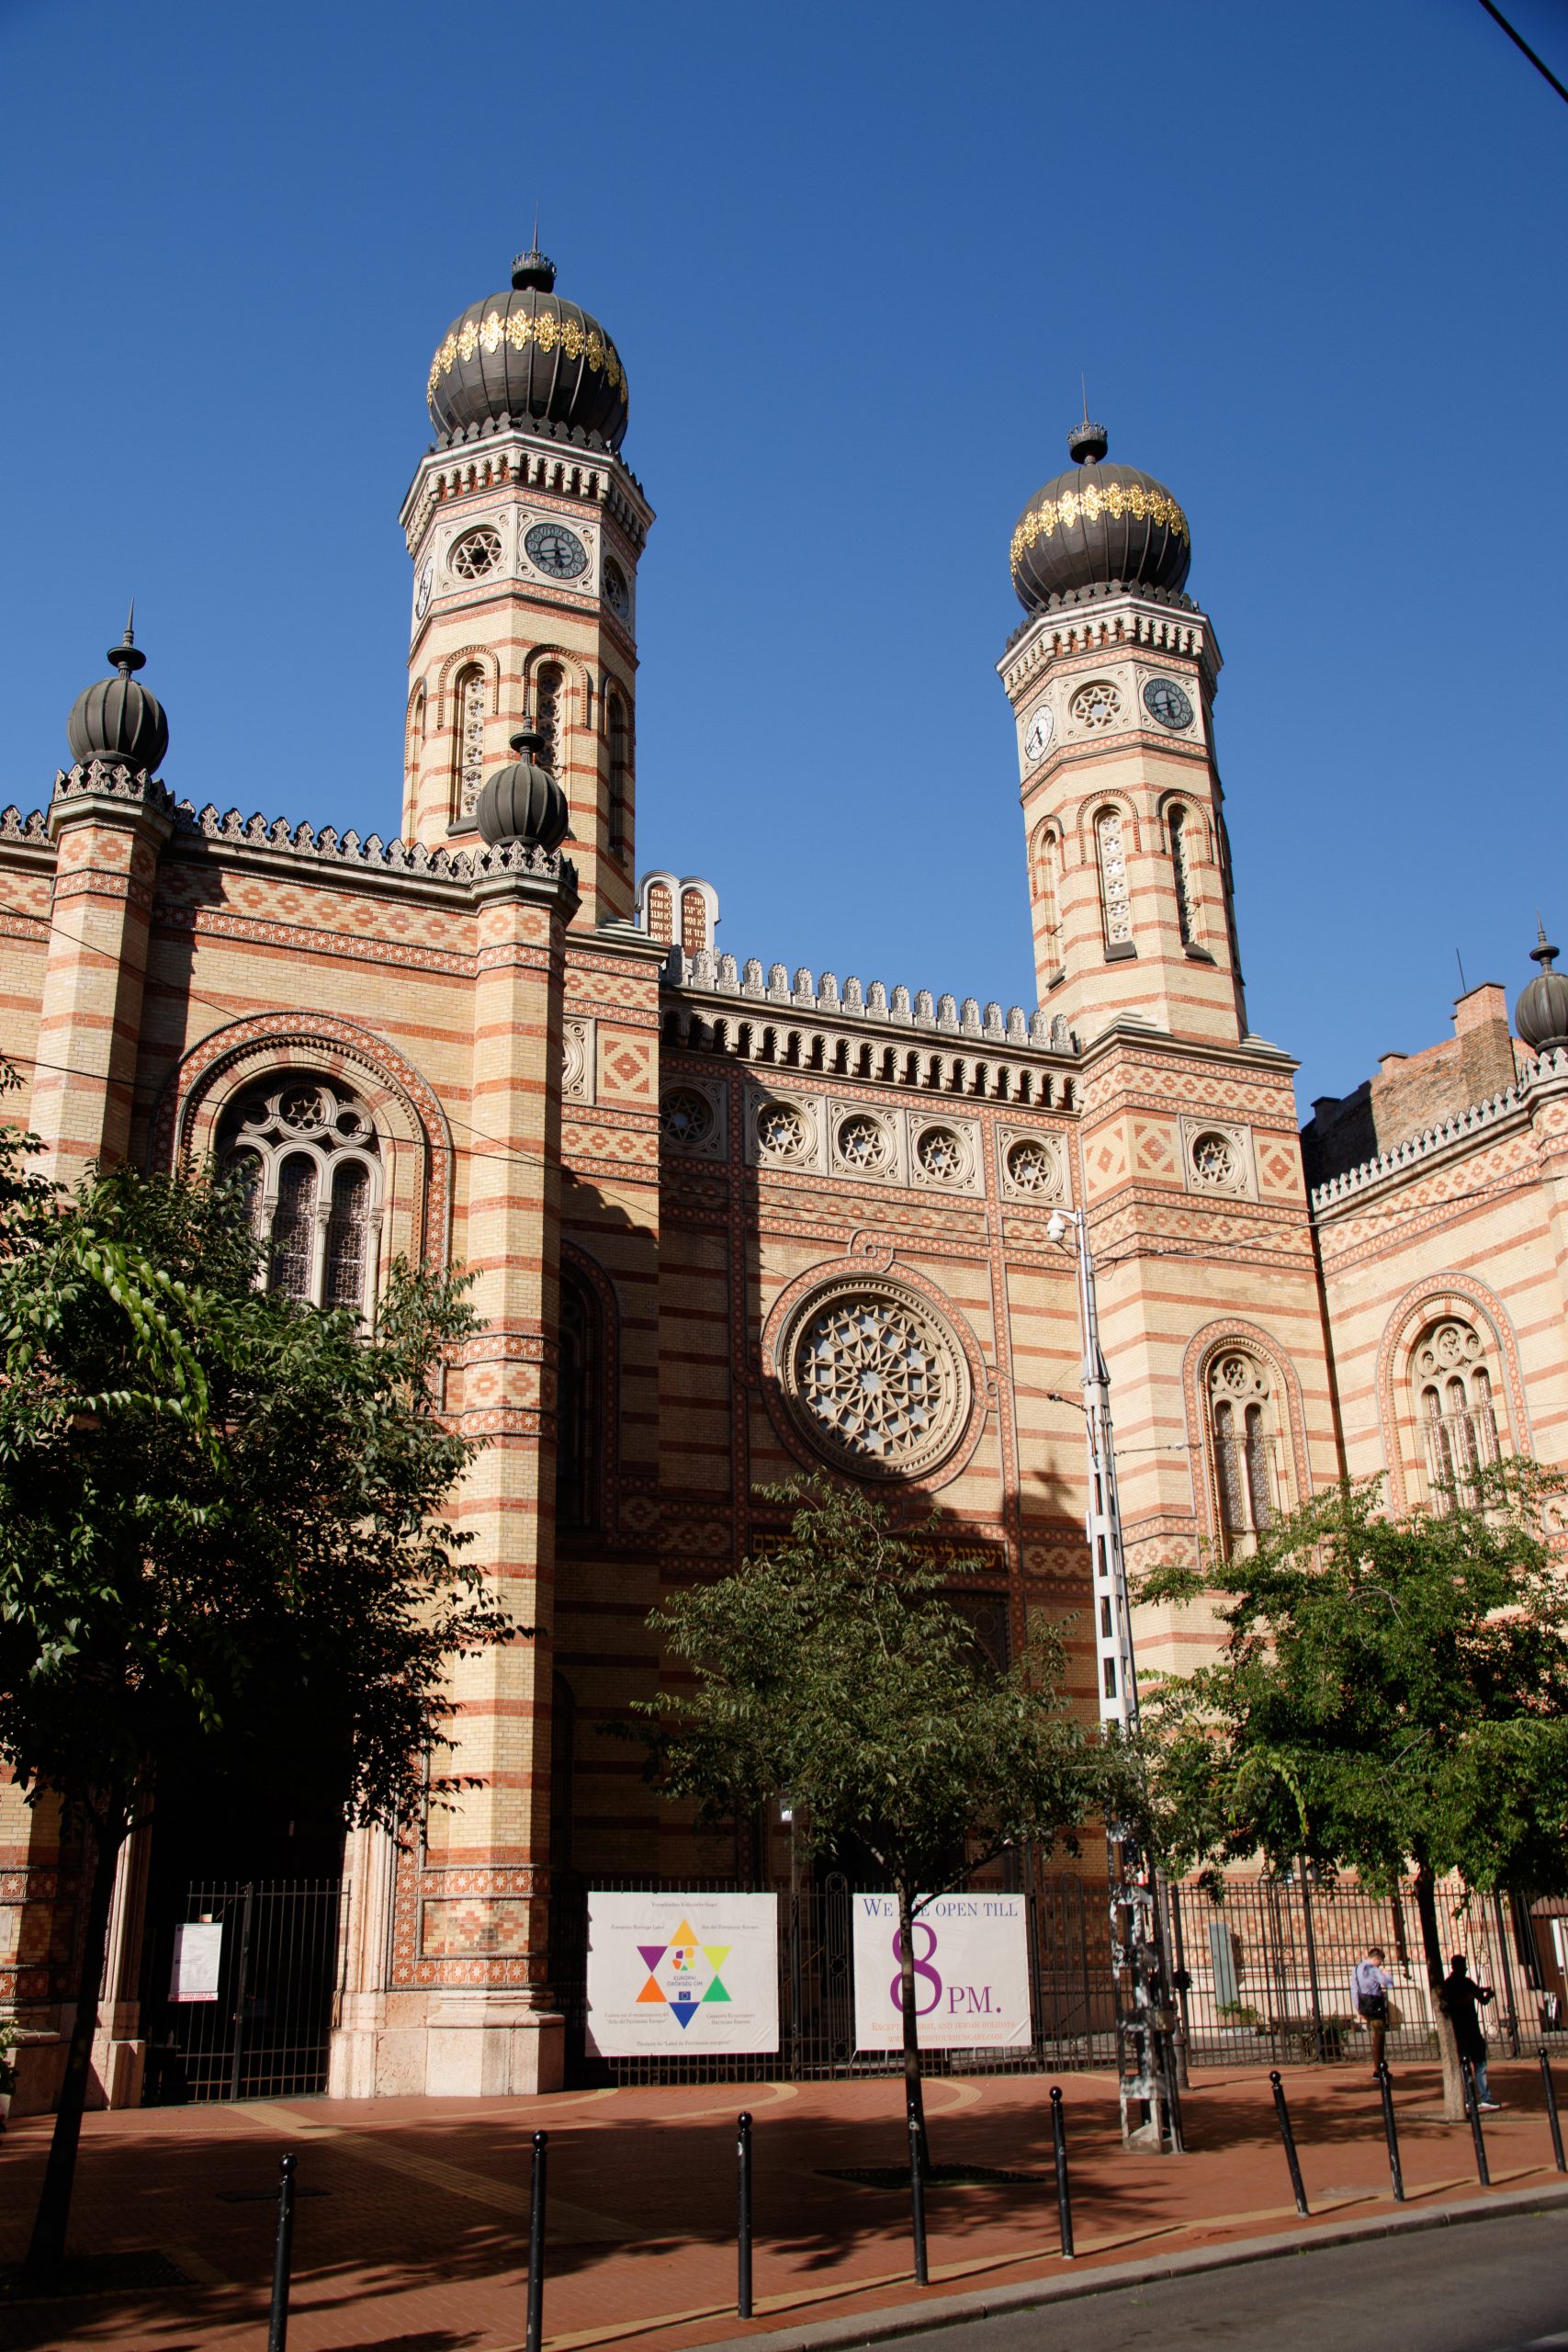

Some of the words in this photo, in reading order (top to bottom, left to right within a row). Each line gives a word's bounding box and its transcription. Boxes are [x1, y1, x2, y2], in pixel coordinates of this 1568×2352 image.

[935, 1902, 978, 1917] OPEN
[983, 1902, 1018, 1917] TILL
[890, 1921, 942, 2016] 8
[946, 1985, 1001, 2014] PM.
